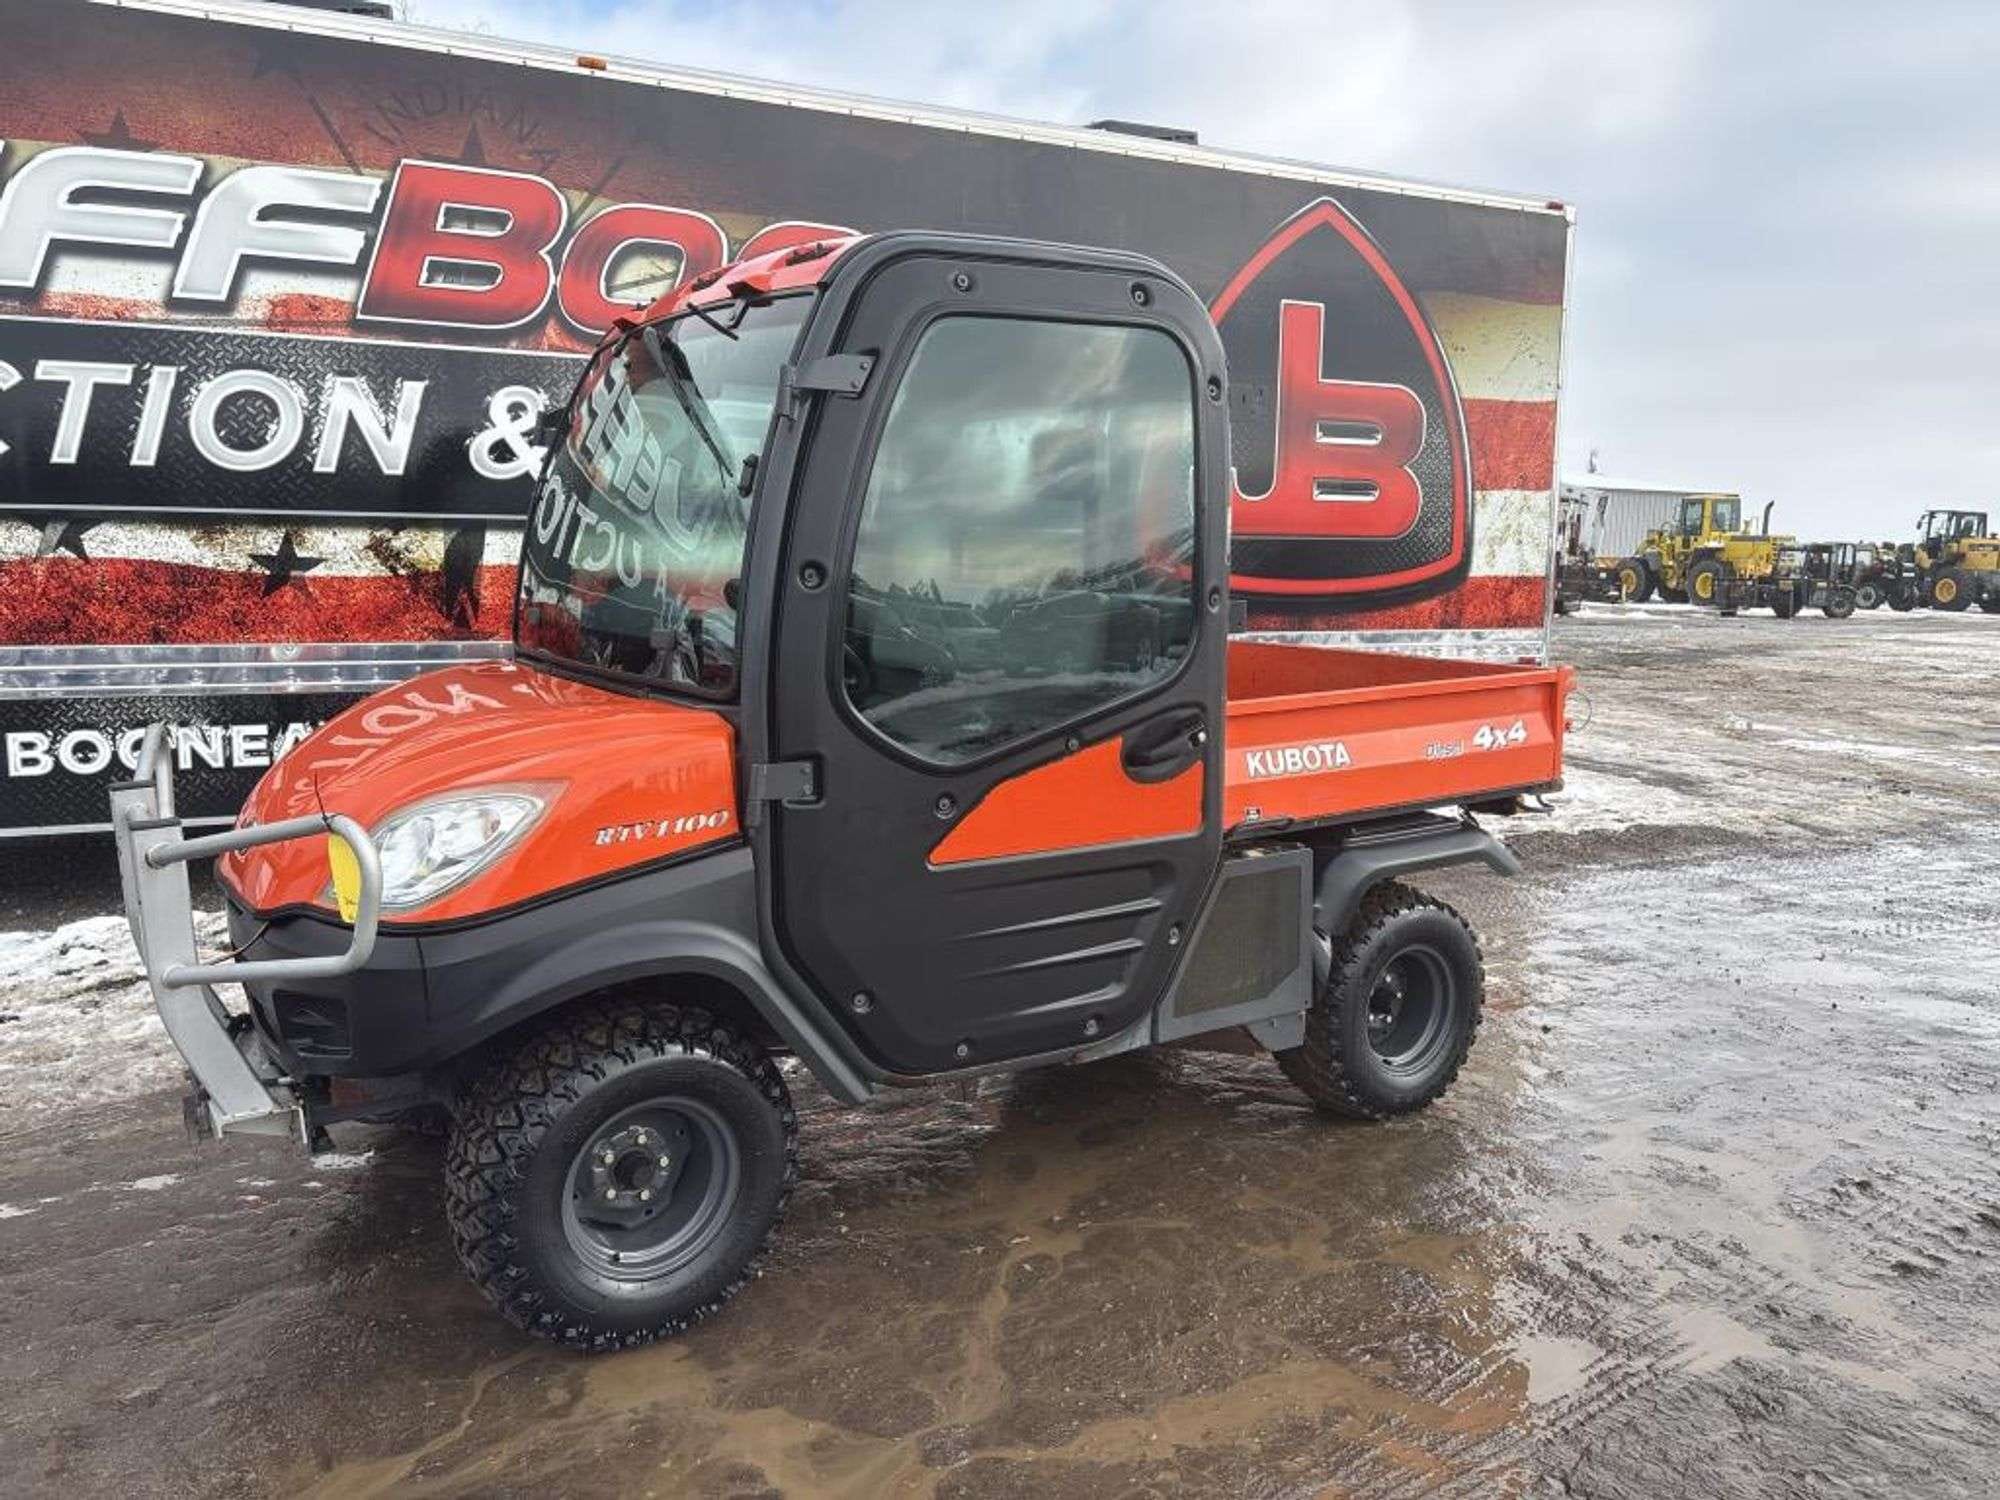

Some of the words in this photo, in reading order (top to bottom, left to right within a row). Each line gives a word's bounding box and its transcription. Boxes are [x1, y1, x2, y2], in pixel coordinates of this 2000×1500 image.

[0, 359, 428, 475] TION
[1472, 719, 1528, 750] 4x4
[1244, 741, 1352, 778] KUBOTA
